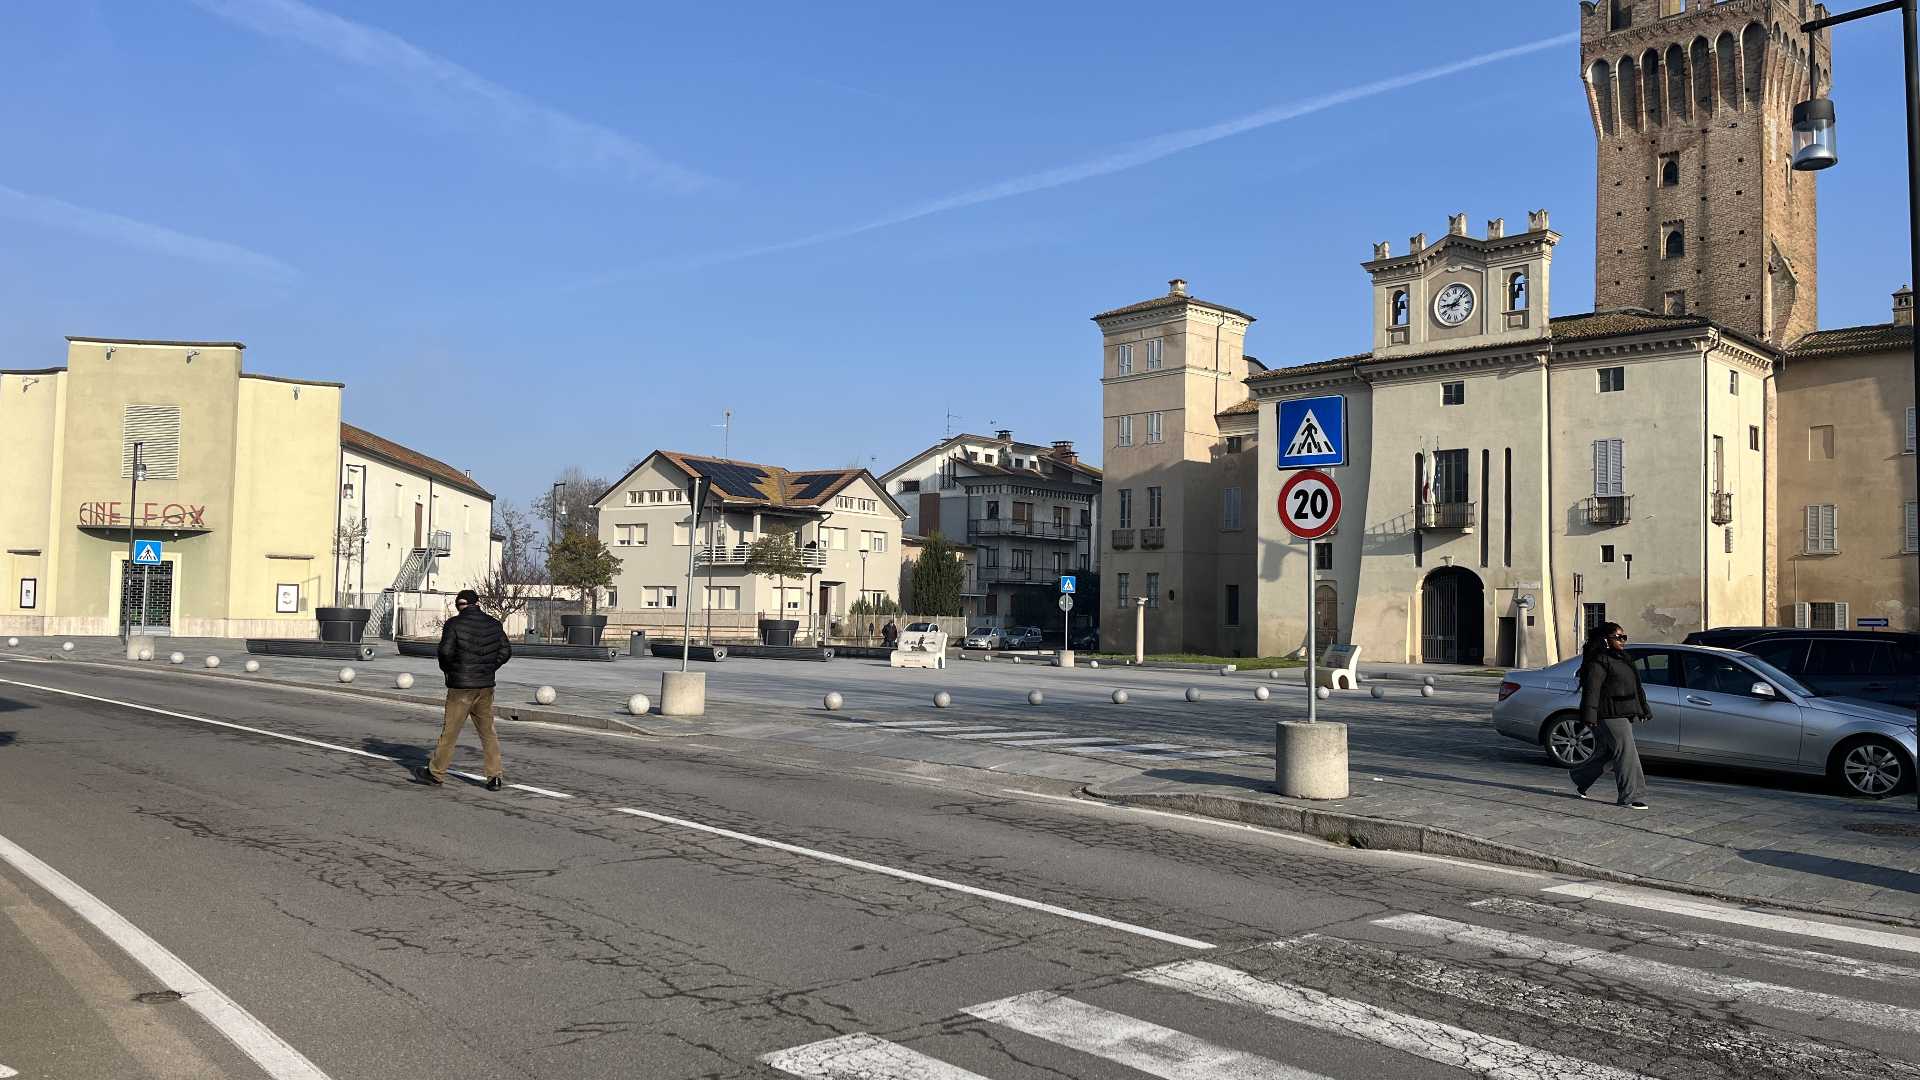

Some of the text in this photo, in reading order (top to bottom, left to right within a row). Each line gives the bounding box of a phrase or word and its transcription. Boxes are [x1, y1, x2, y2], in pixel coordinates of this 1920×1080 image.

[79, 501, 206, 526] CINE FOX
[1294, 489, 1328, 519] 20
